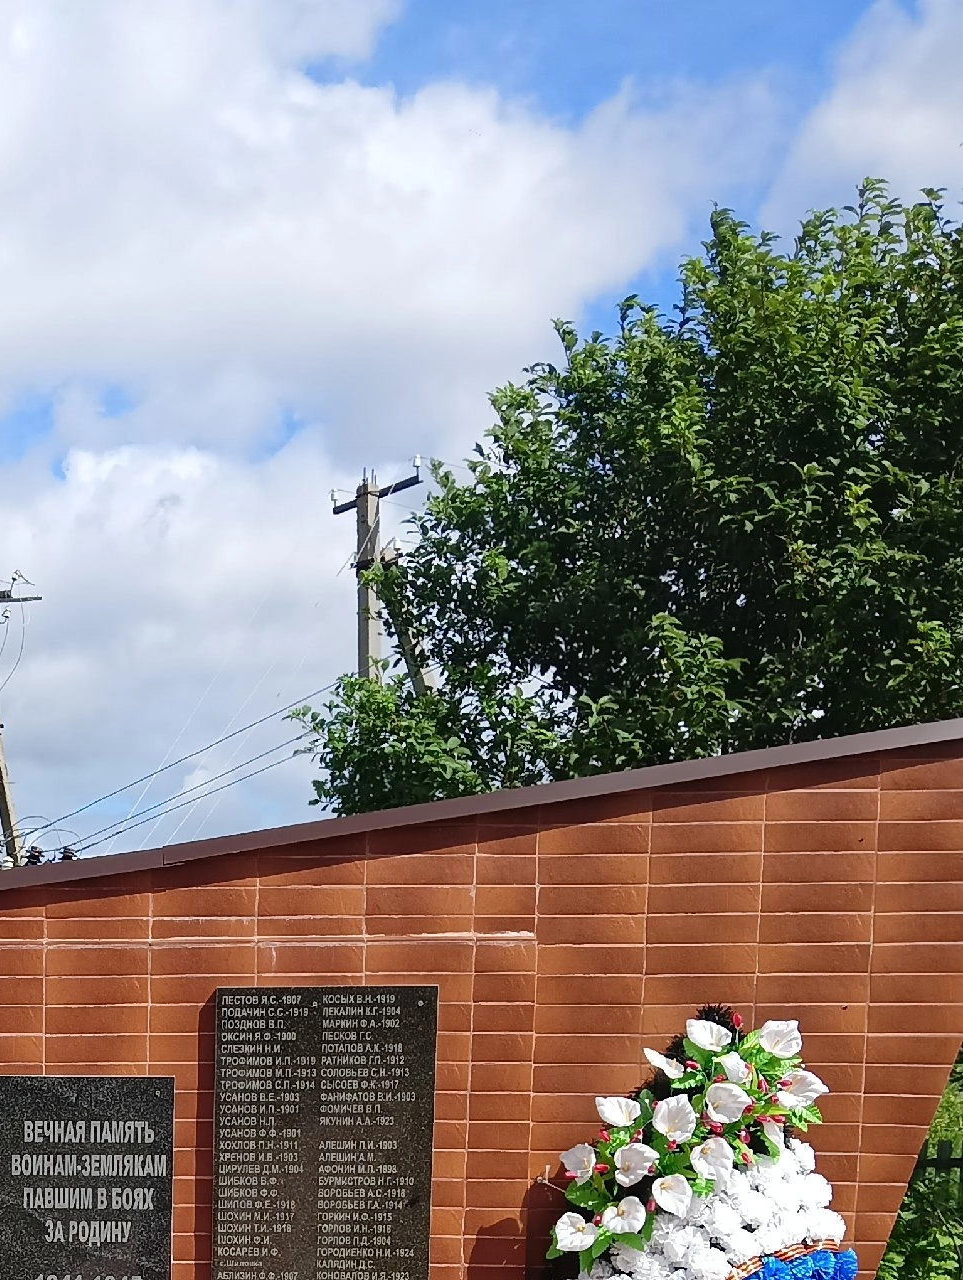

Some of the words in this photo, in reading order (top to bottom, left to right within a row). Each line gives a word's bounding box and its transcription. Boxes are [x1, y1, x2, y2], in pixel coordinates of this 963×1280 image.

[222, 996, 258, 1005] ПЕСТОВ
[323, 995, 354, 1004] КОСЫХ
[222, 1008, 265, 1017] ПОДАЧИН
[222, 1020, 265, 1029] ПОЗДНОВ
[323, 1020, 358, 1028] МАРКИН
[222, 1032, 252, 1041] ОКСИН
[323, 1032, 356, 1040] ПЕСКОВ
[222, 1045, 262, 1053] СЛЕЗКИН
[322, 1044, 363, 1053] ПОТАПОВ
[220, 1057, 272, 1065] ТРОФИМОВ
[321, 1056, 366, 1065] РАТНИКОВ
[220, 1069, 272, 1077] ТРОФИМОВ
[321, 1068, 368, 1077] СОЛОВЬЕВ
[220, 1080, 272, 1090] ТРОФИМОВ
[321, 1080, 358, 1089] СЫСОЕВ
[220, 1093, 257, 1101] УСАНОВ
[321, 1092, 375, 1101] ФАНИФАТОВ
[220, 1105, 257, 1113] УСАНОВ
[320, 1105, 363, 1113] ФОМИЧЕВ
[220, 1117, 256, 1125] УСАНОВ
[320, 1117, 353, 1125] ЯКУНИН
[24, 1121, 86, 1144] ВЕЧНАЯ
[90, 1121, 154, 1144] ПАМЯТЬ
[220, 1129, 256, 1138] УСАНОВ
[220, 1141, 256, 1149] ХОХЛОВ
[319, 1141, 356, 1149] АЛЕШИН
[220, 1153, 255, 1161] ХРЕНОВ
[319, 1153, 356, 1161] АЛЕШИН
[11, 1154, 167, 1177] ВОИНАМ-ЗЕМЛЯКАМ
[319, 1165, 355, 1173] АФОНИН
[219, 1165, 260, 1175] ЦИРУЛЕВ
[219, 1177, 257, 1185] ШИБКОВ
[319, 1176, 375, 1185] БУРМИСТРОВ
[218, 1189, 257, 1197] ШИБКОВ
[318, 1189, 365, 1197] ВОРОБЬЕВ
[23, 1188, 94, 1210] ПАВШИМ
[97, 1188, 108, 1209] В
[111, 1188, 154, 1211] БОЯХ
[218, 1200, 252, 1208] ШИПОВ
[318, 1201, 365, 1209] ВОРОБЬЕВ
[218, 1212, 251, 1220] ШОХИН
[218, 1224, 251, 1232] ШОХИН
[317, 1224, 351, 1232] ГОРЛОВ
[45, 1221, 65, 1243] ЗА
[69, 1221, 131, 1246] РОДИНУ
[218, 1235, 250, 1244] ШОХИН
[317, 1236, 350, 1244] ГОРЛОВ
[218, 1247, 259, 1256] КОСАРЕВ
[317, 1248, 374, 1258] ГОРОДИЕНКО
[317, 1272, 369, 1280] КОНОВАЛОВ
